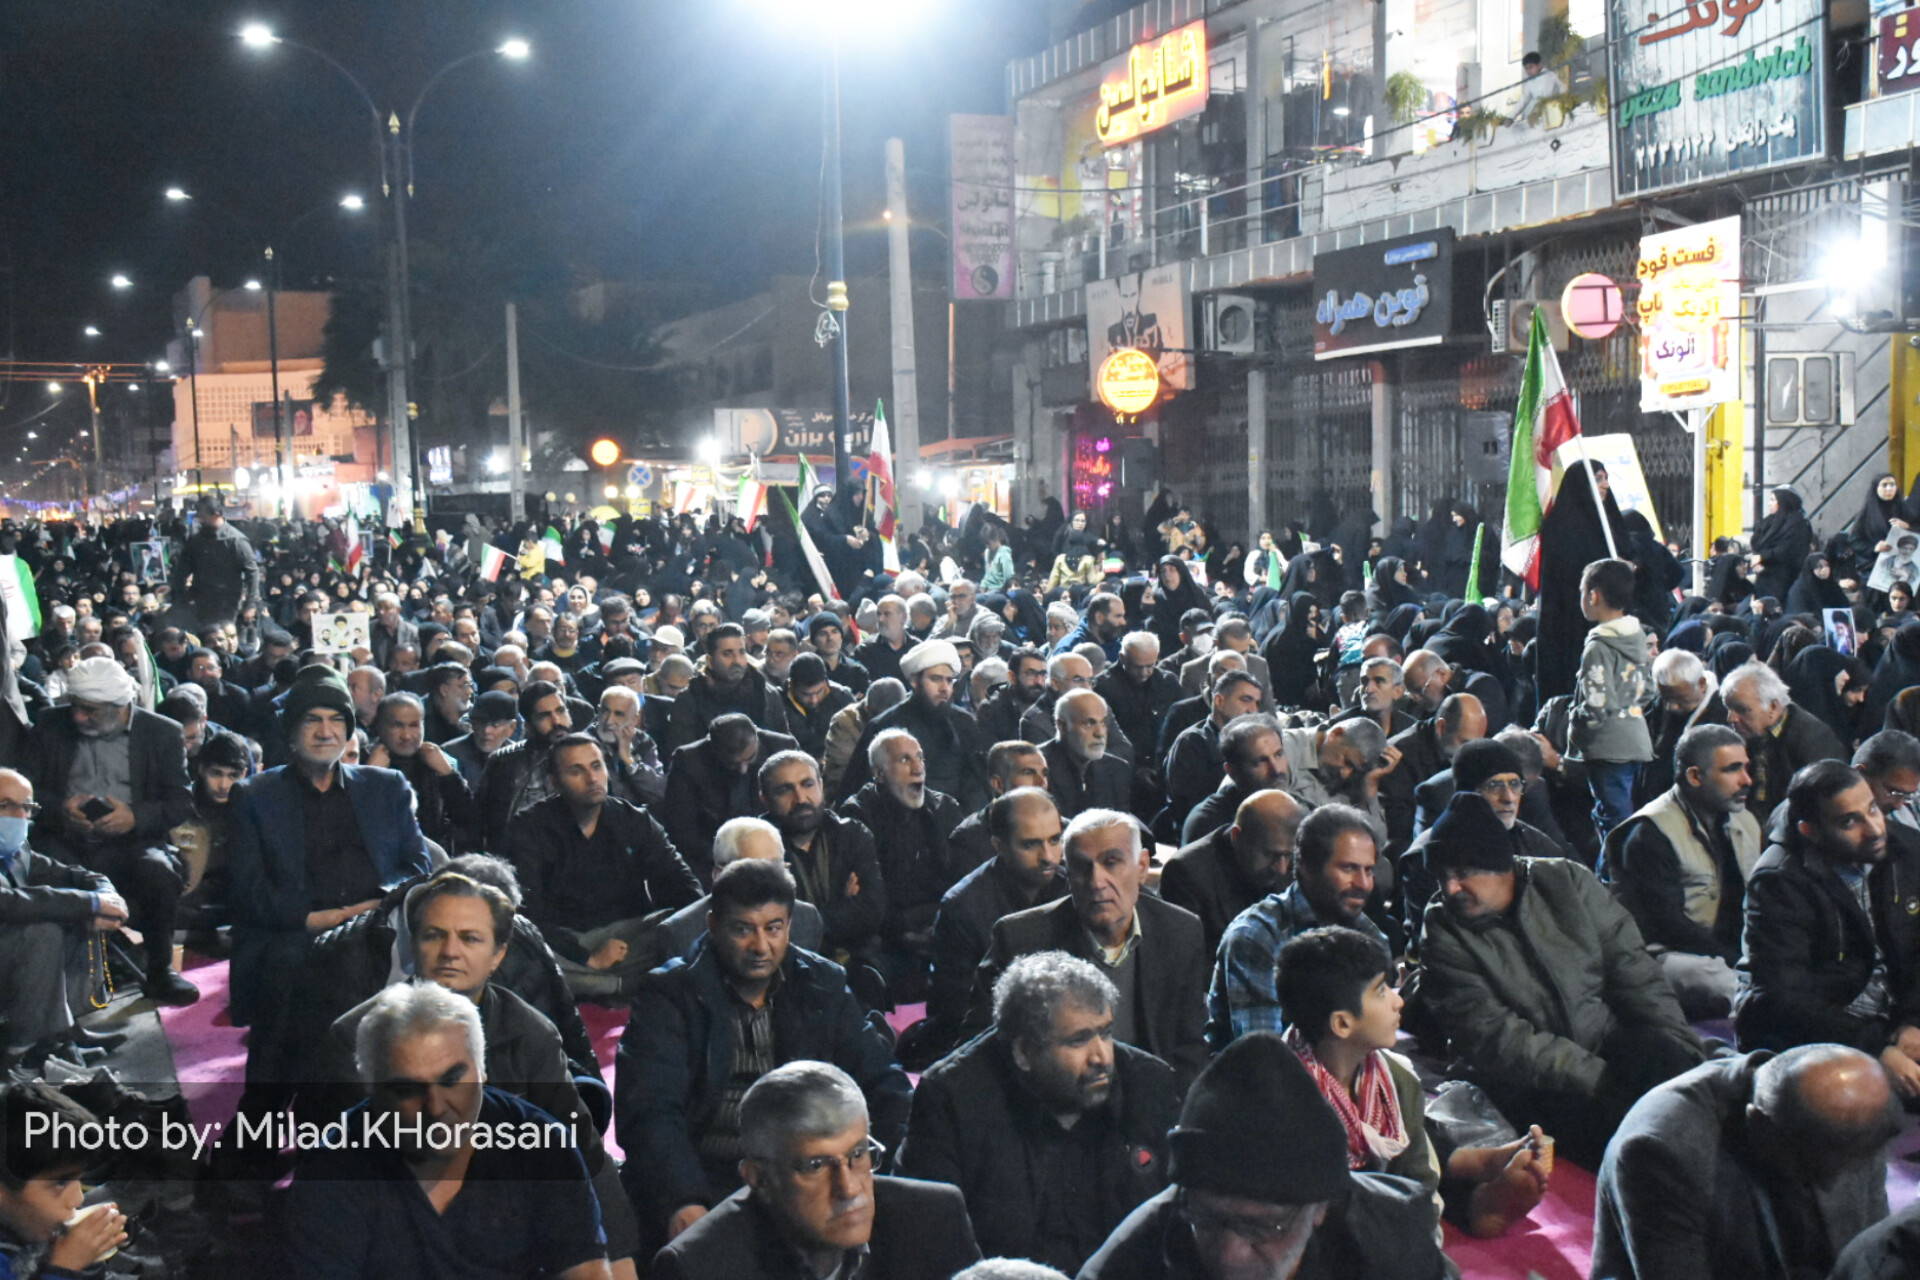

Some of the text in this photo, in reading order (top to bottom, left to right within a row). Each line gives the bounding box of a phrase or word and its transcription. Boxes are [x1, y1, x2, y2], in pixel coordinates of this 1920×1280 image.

[1619, 35, 1813, 129] pizza sandwich
[1639, 236, 1716, 280] فست فود
[1316, 273, 1429, 336] نوین همراه
